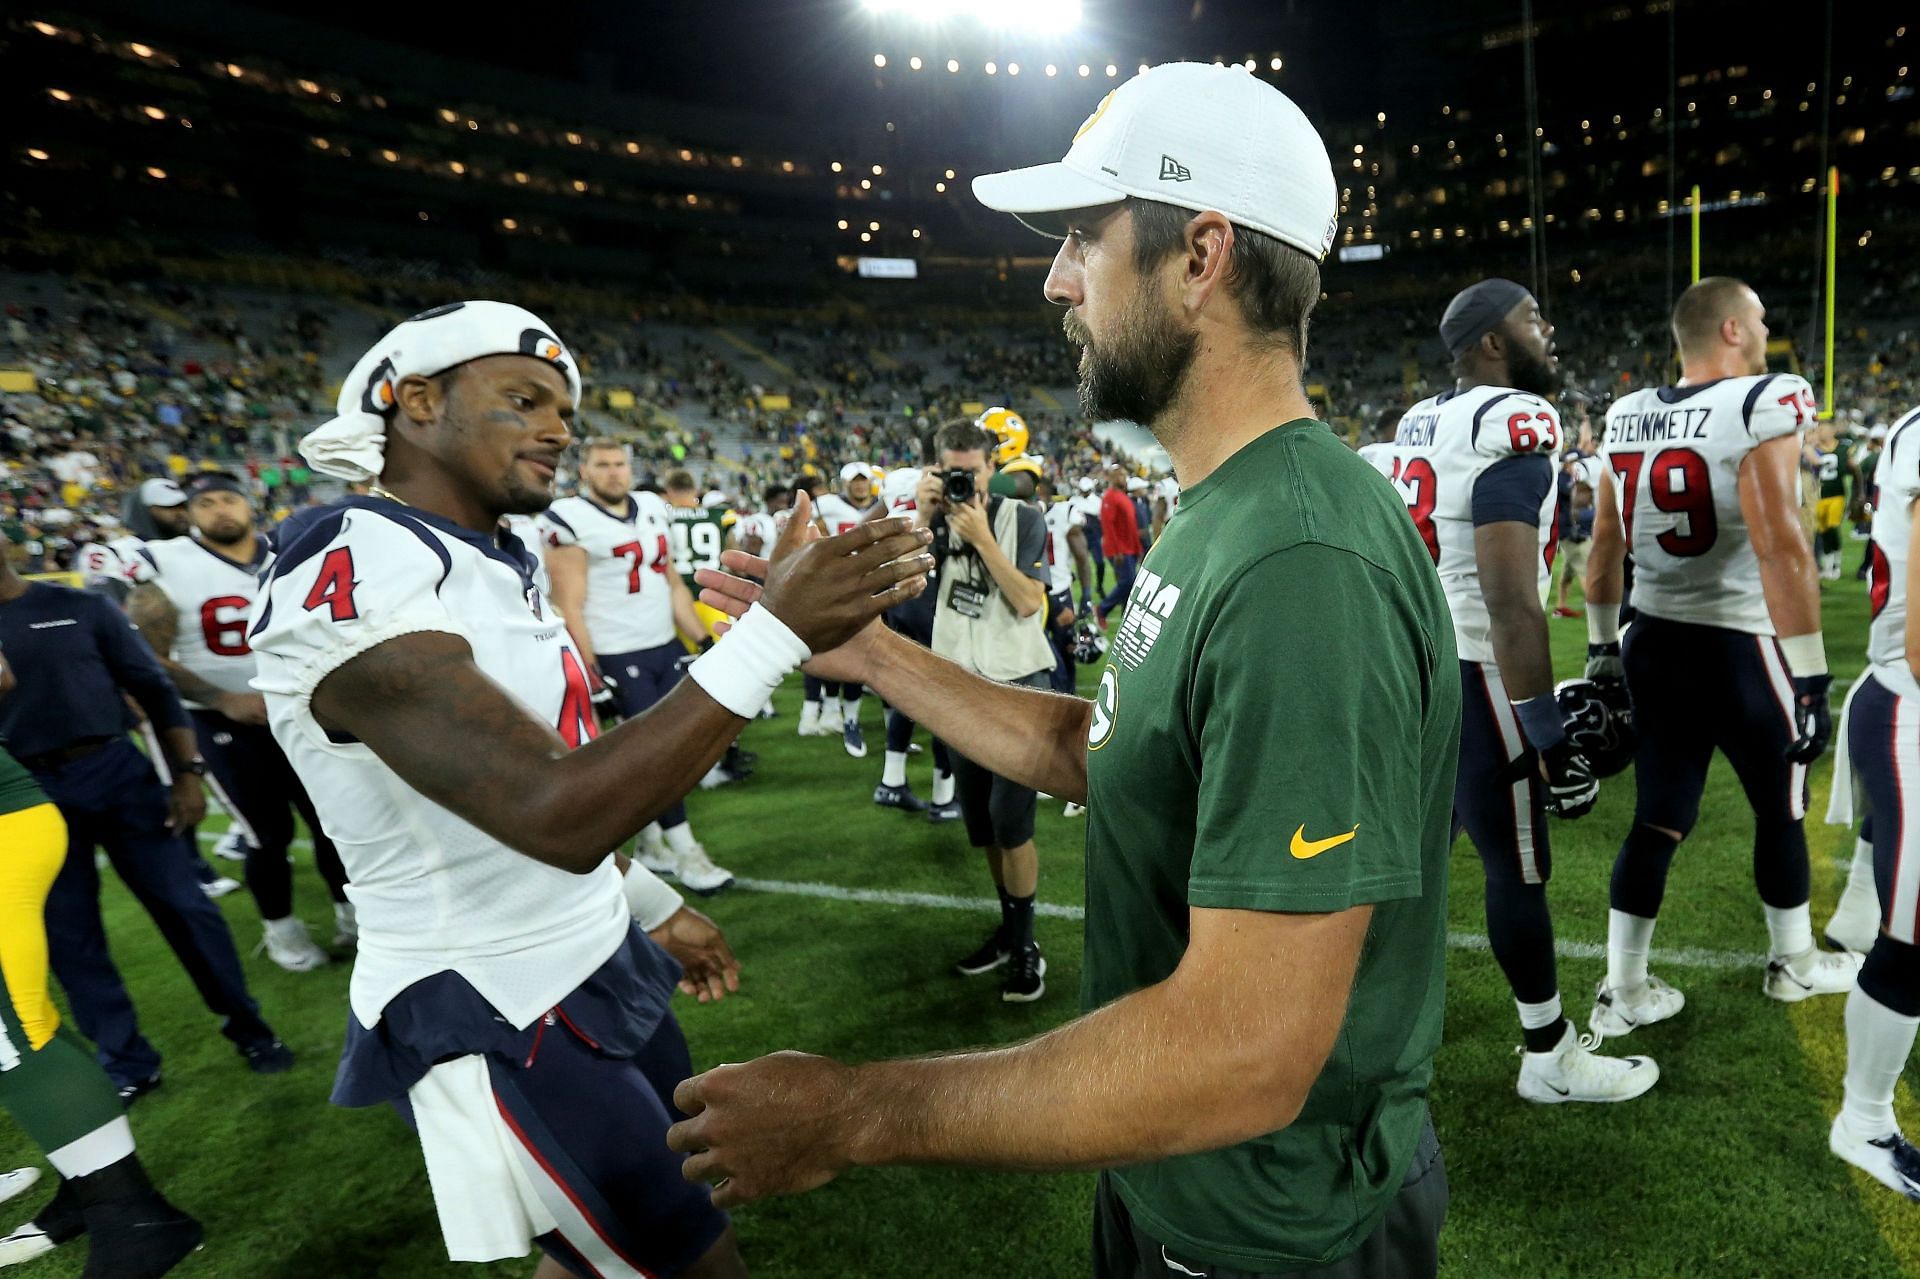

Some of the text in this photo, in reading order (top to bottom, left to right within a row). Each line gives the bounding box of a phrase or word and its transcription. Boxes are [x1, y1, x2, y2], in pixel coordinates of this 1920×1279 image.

[1508, 412, 1558, 451] 63
[1610, 408, 1712, 443] STEINMETZ
[1390, 456, 1440, 567] 3
[1609, 447, 1718, 557] 79
[303, 545, 363, 622] 4
